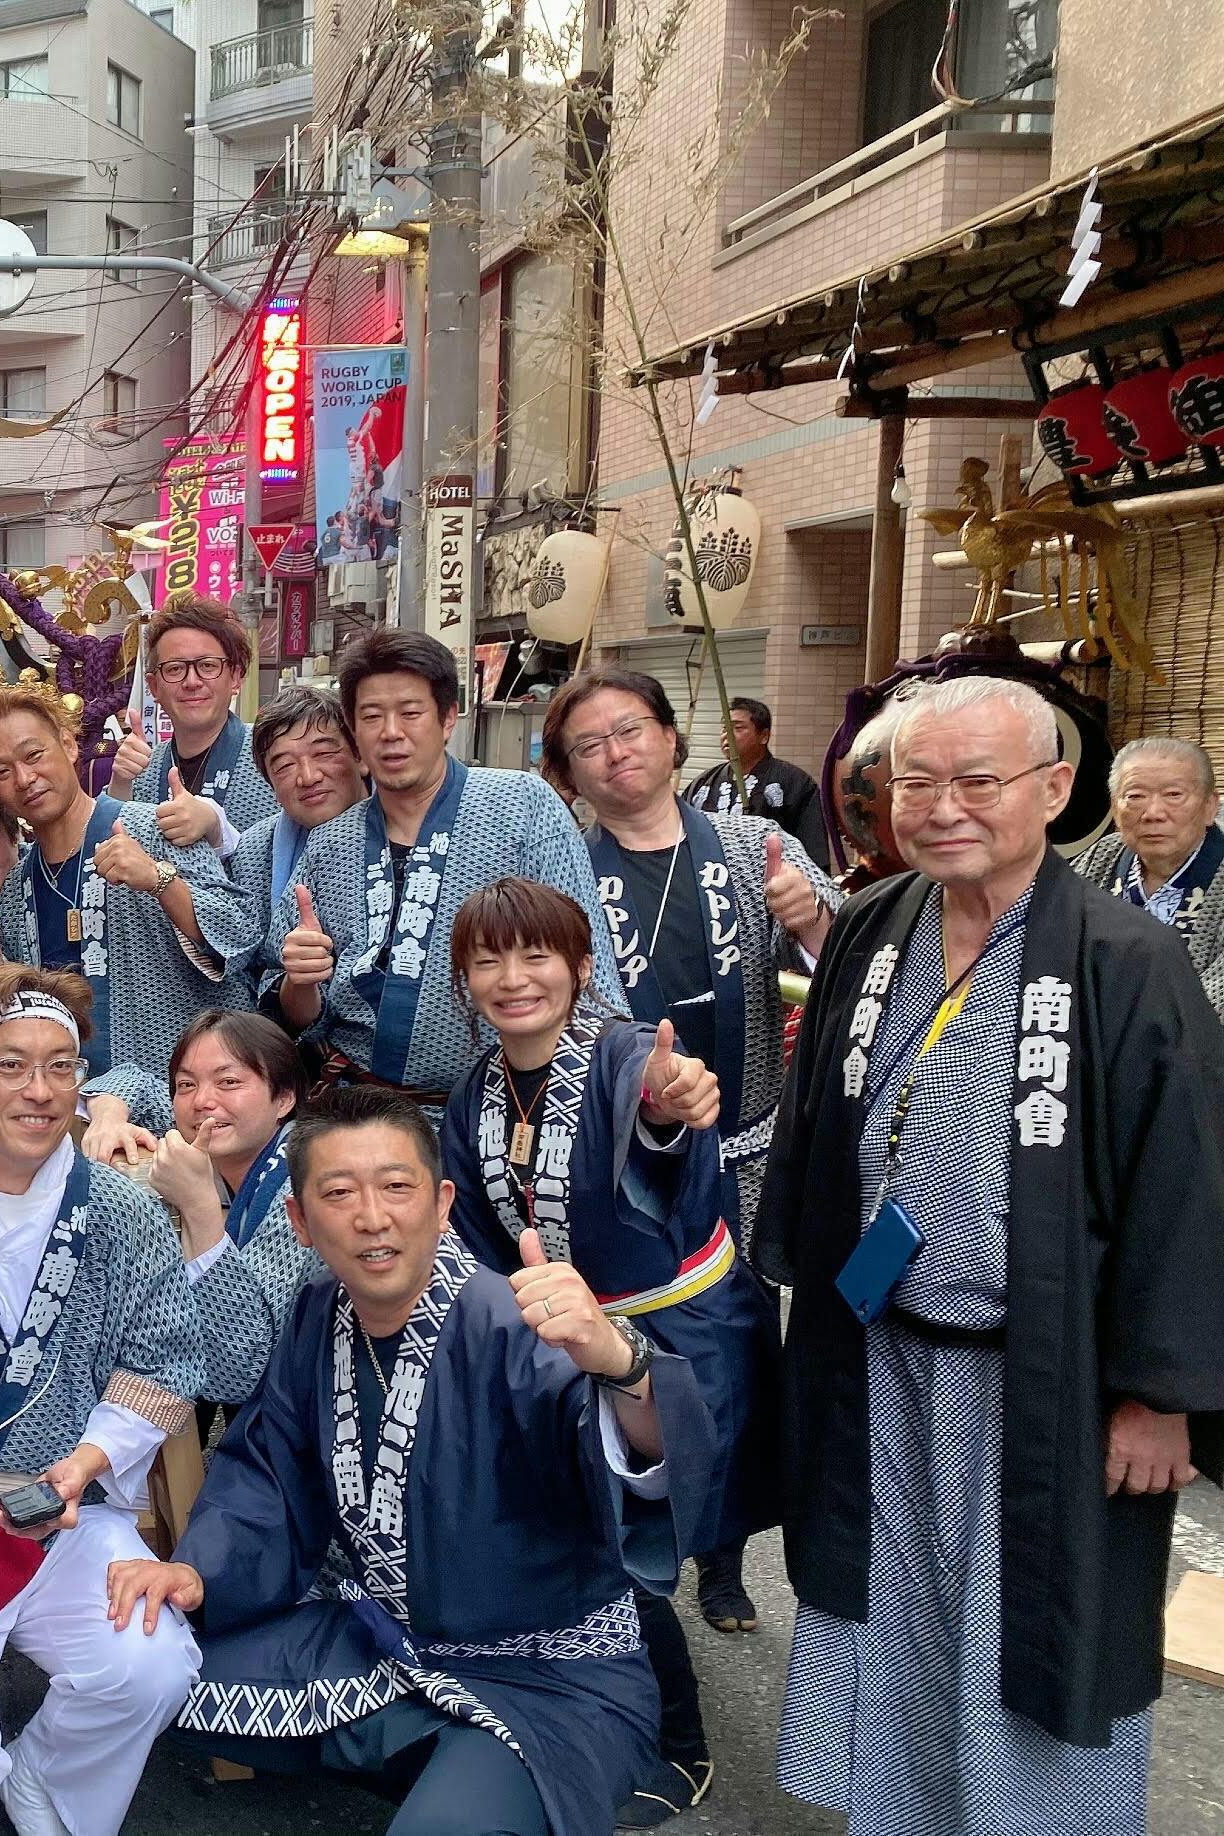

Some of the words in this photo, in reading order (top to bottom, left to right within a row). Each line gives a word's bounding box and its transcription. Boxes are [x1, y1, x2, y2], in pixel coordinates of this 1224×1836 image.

[321, 365, 370, 379] RUGBY
[321, 379, 373, 393] WORLD
[375, 377, 402, 390] CUP
[321, 395, 356, 408] 2019,
[358, 391, 402, 406] JAPAN
[429, 486, 471, 500] HOTEL
[256, 533, 286, 545] 止まれ
[439, 513, 464, 631] MaSHA
[81, 856, 108, 977] 二南町會
[698, 860, 742, 977] カトレア
[596, 875, 649, 988] カトレア
